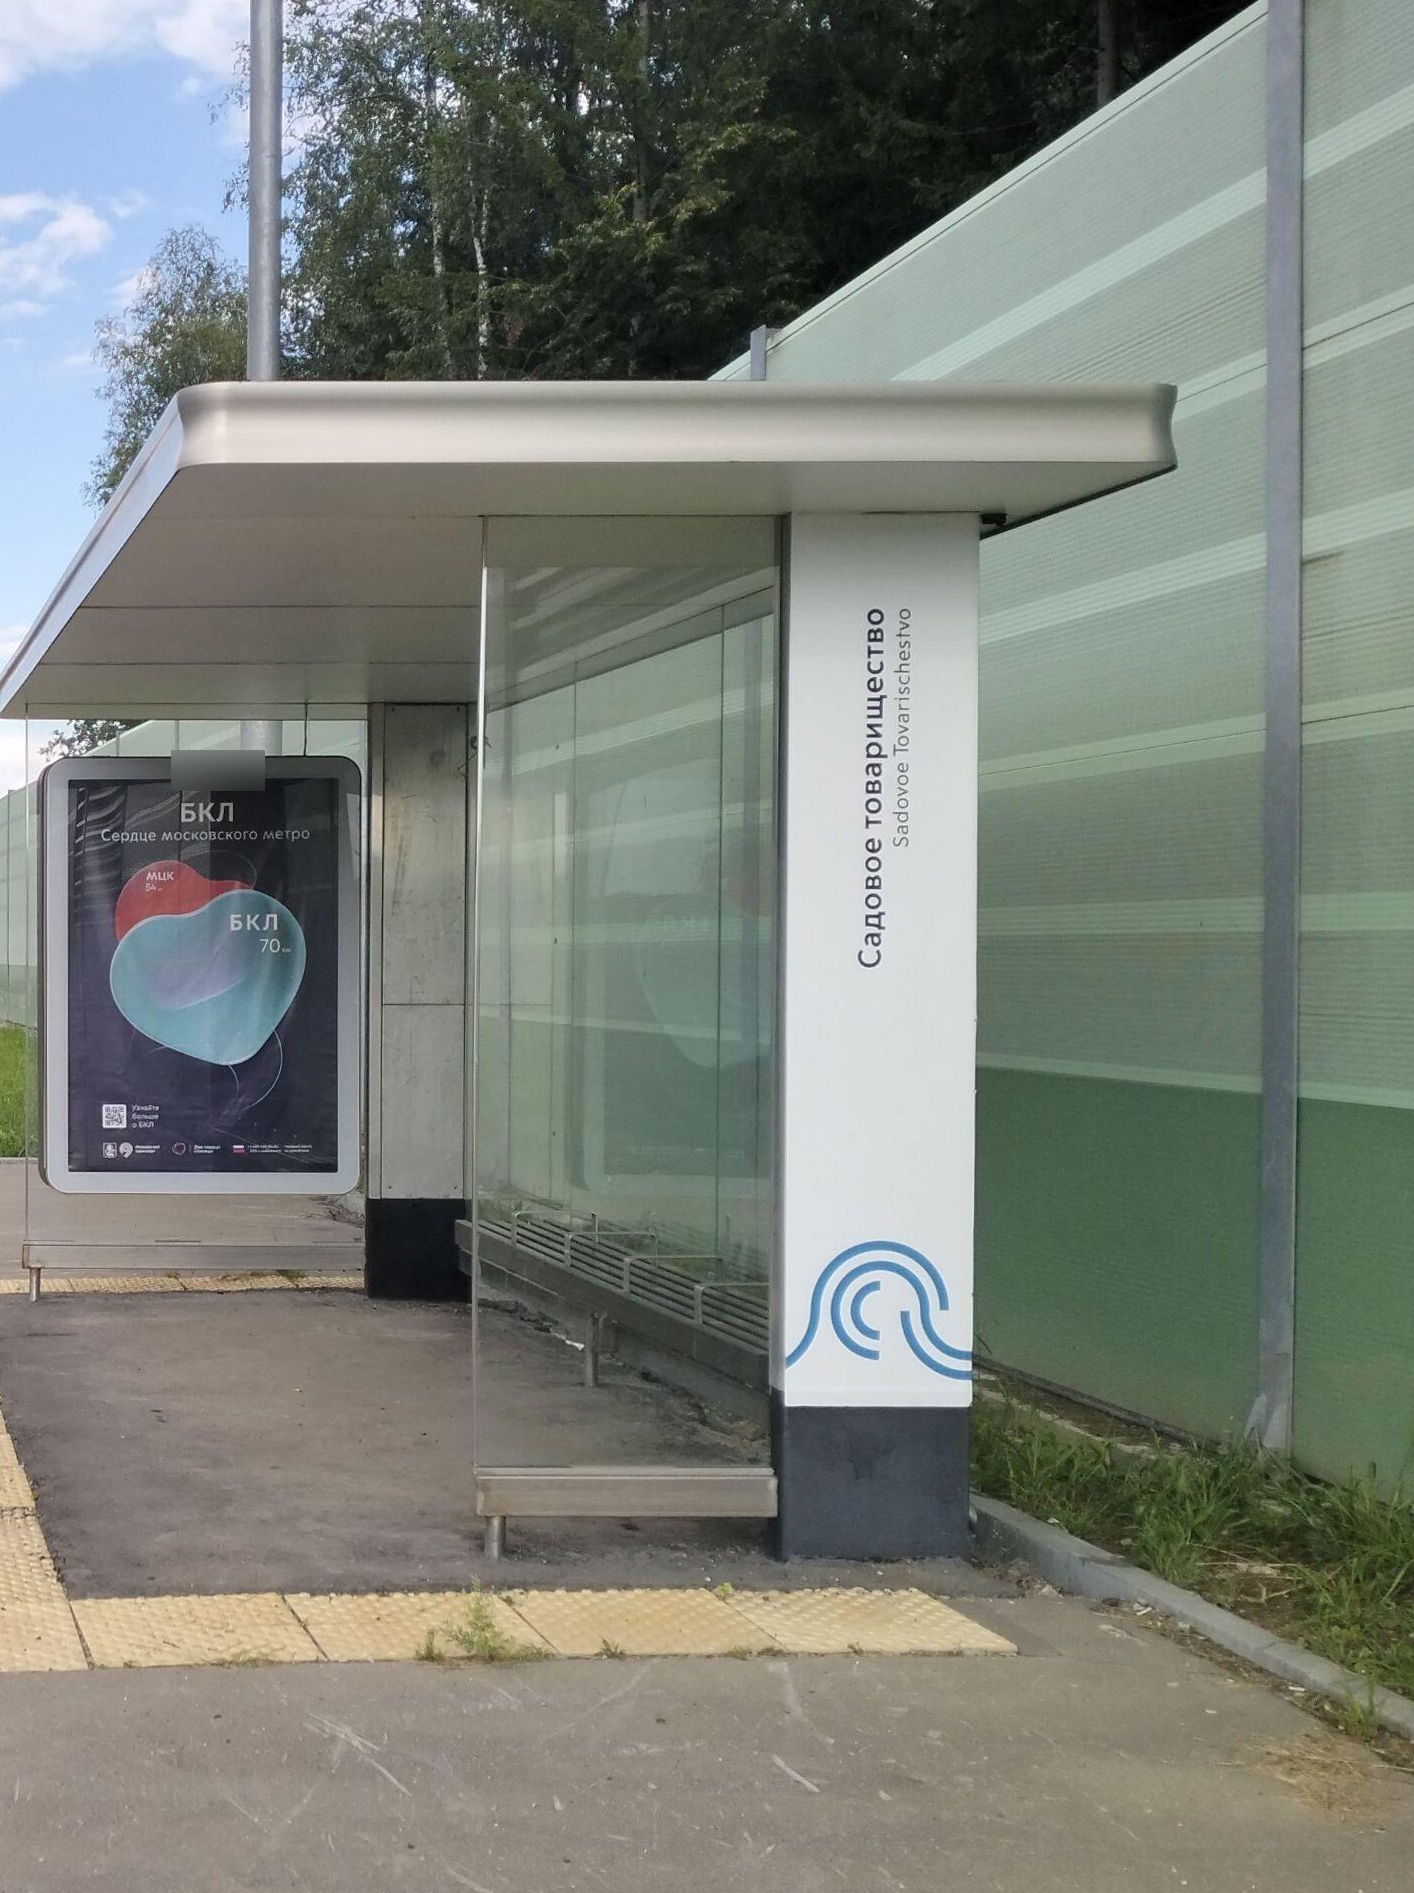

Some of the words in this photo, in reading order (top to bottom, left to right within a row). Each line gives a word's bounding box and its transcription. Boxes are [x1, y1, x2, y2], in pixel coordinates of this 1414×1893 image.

[892, 607, 912, 757] Tovarischestvo
[864, 607, 888, 830] товарищество
[180, 802, 234, 822] БКЛ
[892, 762, 909, 848] Sadovoe
[100, 828, 157, 843] Сердце
[161, 830, 258, 842] московского
[262, 828, 311, 842] метро
[146, 871, 174, 882] МЦК
[857, 837, 886, 968] Садовое
[229, 914, 278, 931] БКЛ
[259, 938, 281, 953] 70
